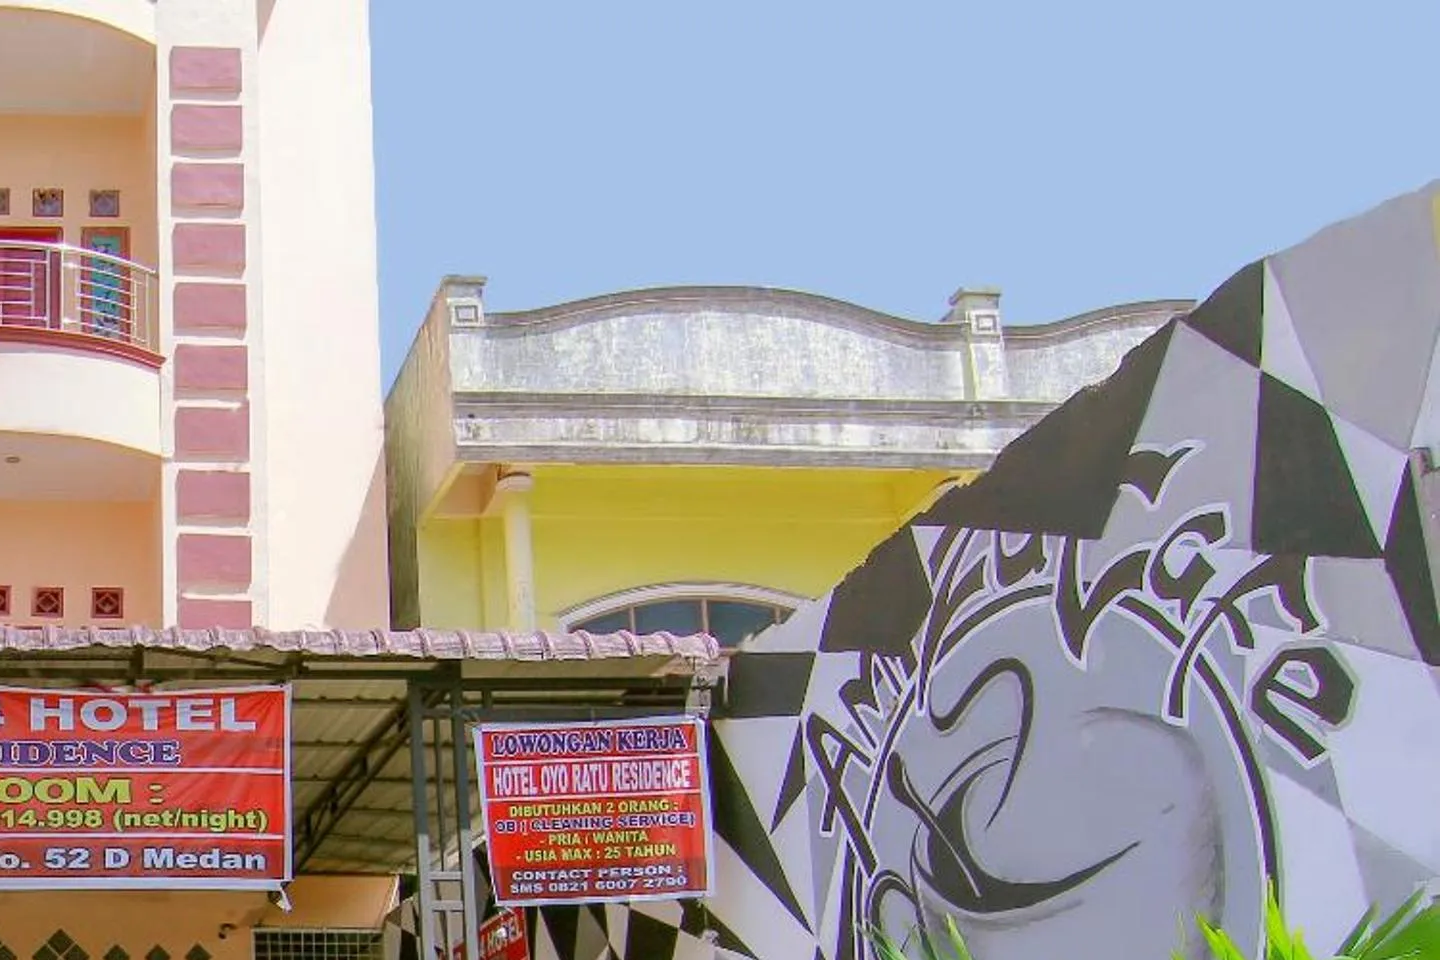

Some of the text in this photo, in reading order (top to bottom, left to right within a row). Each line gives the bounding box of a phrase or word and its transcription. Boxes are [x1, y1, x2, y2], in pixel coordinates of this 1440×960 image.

[29, 696, 257, 731] HOTEL
[492, 728, 687, 757] LOWONGAN KERJA
[493, 760, 692, 796] HOTEL OYO RATU RESIDENCE
[509, 803, 602, 818] DIBUTUHKAN
[606, 802, 615, 813] 2
[618, 800, 670, 813] ORANG
[113, 809, 268, 833] (net/night)
[530, 816, 613, 832] CLEANING
[548, 832, 581, 845] PRIA
[593, 831, 649, 844] WANITA
[45, 848, 91, 869] 52
[104, 848, 130, 869] D
[143, 848, 266, 871] Medan
[524, 849, 558, 862] USIA
[561, 848, 593, 861] MAX
[604, 846, 621, 859] 25
[625, 844, 677, 858] TAHUN
[512, 869, 593, 881] CONTACT
[597, 865, 672, 878] PERSON
[510, 882, 544, 894] SMS
